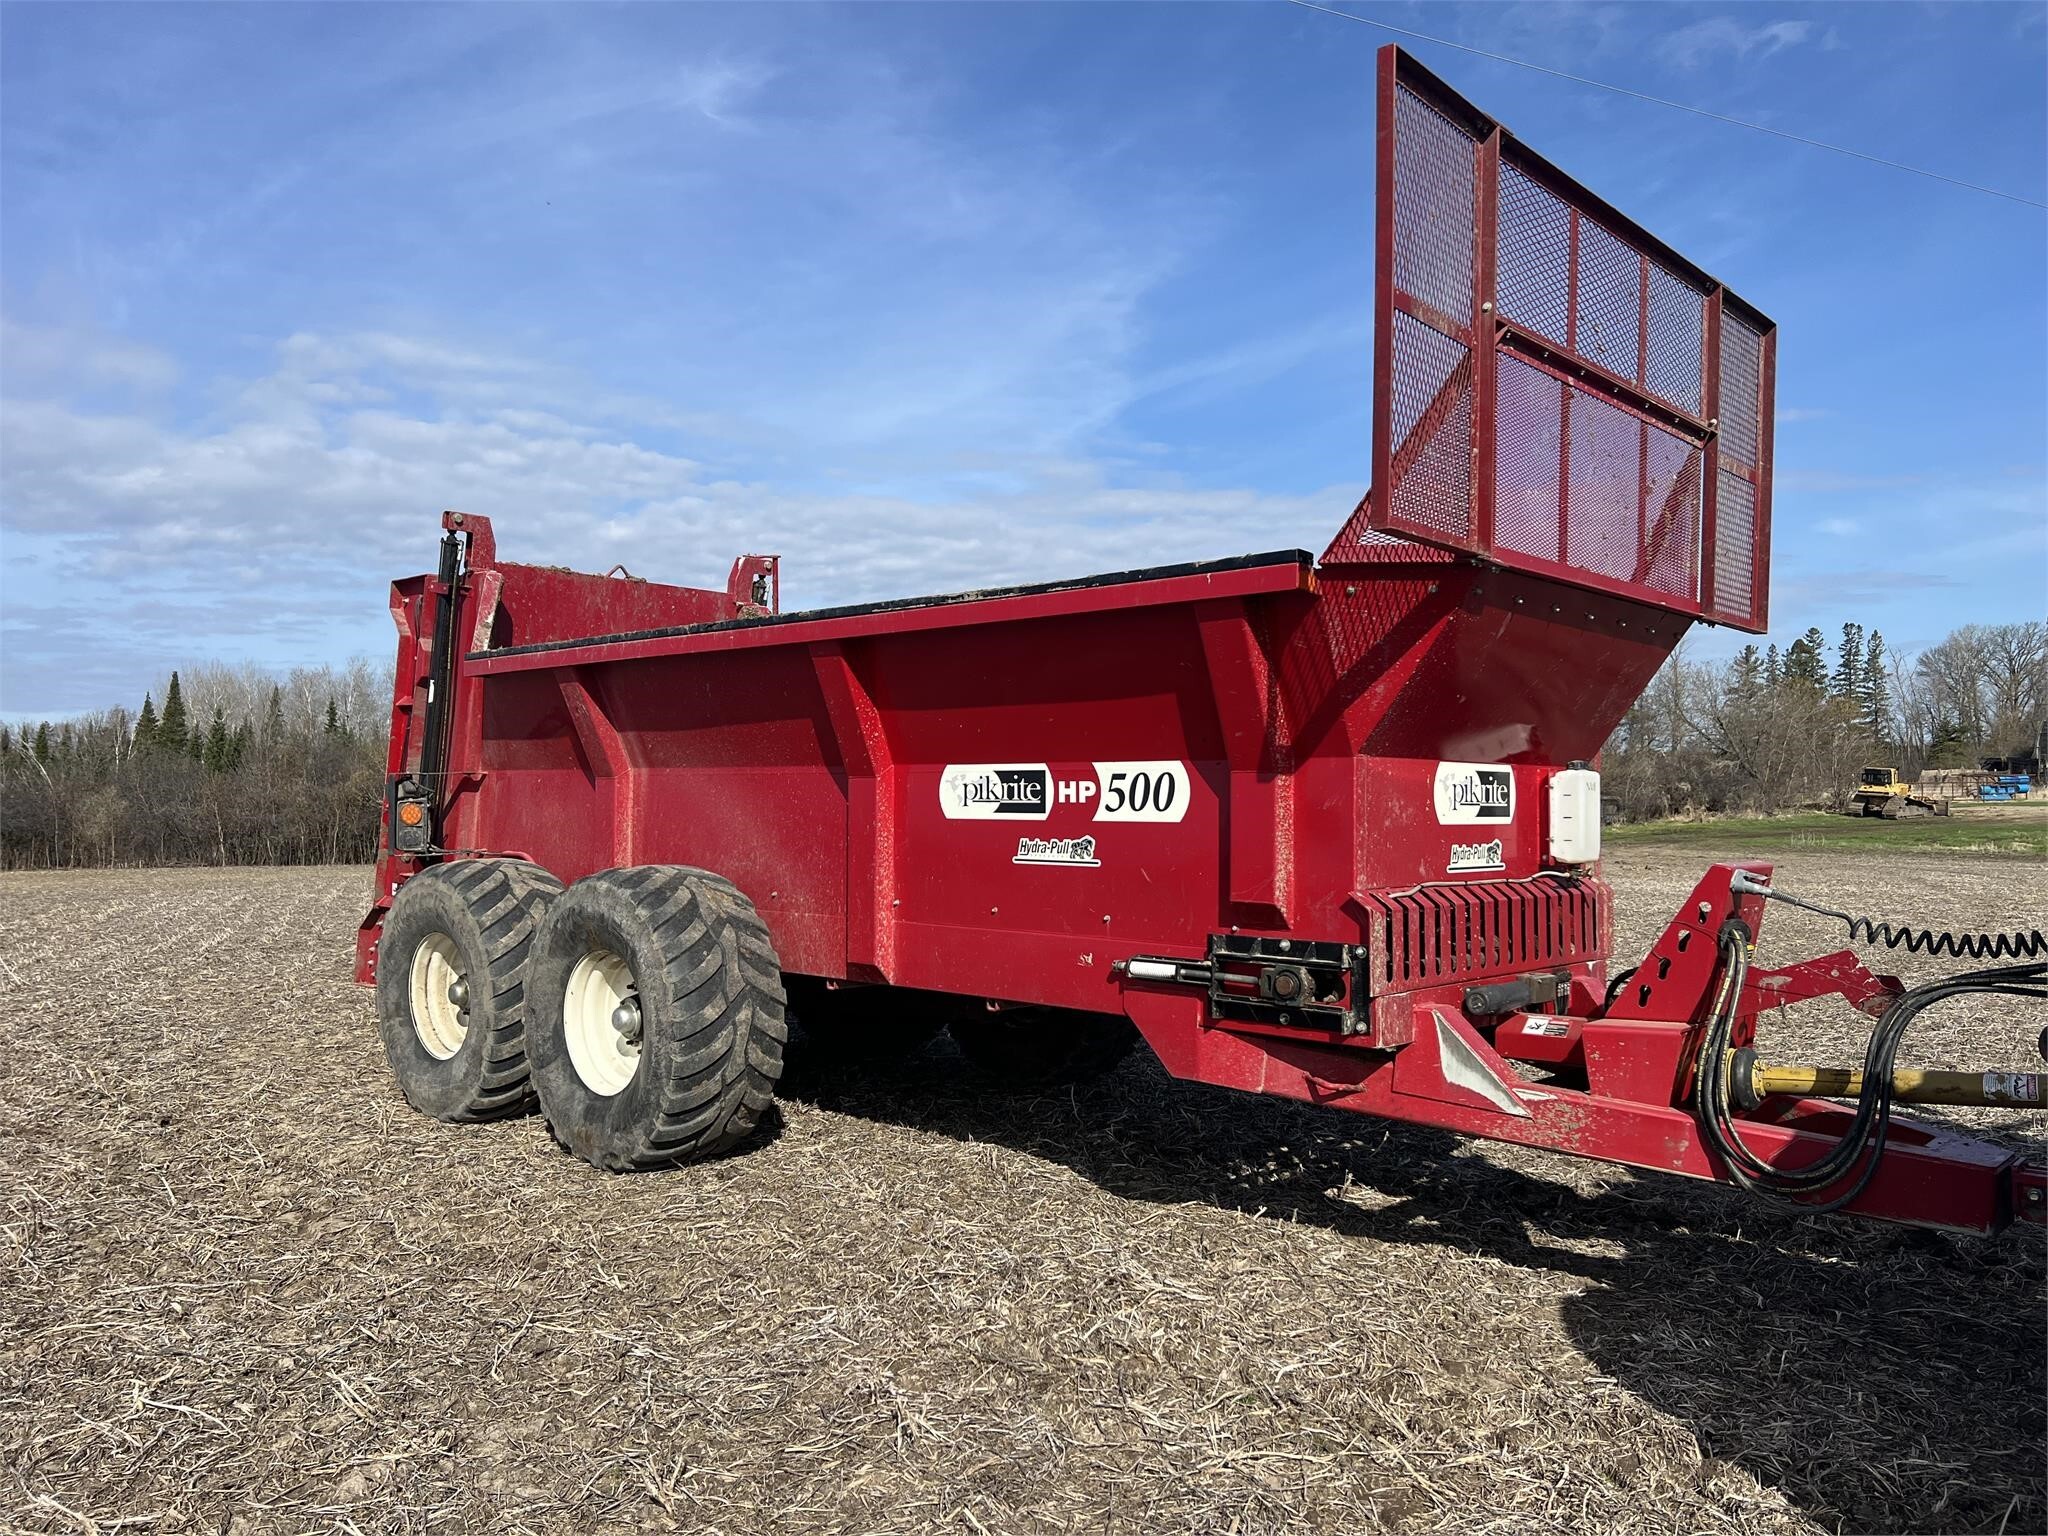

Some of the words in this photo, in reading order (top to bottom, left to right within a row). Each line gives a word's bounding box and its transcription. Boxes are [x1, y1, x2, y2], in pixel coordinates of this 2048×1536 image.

[1058, 780, 1097, 803] HP
[1104, 771, 1176, 812] 500
[1019, 839, 1070, 856] Hydra-Pull
[1451, 845, 1486, 864] Hydra-Pull
